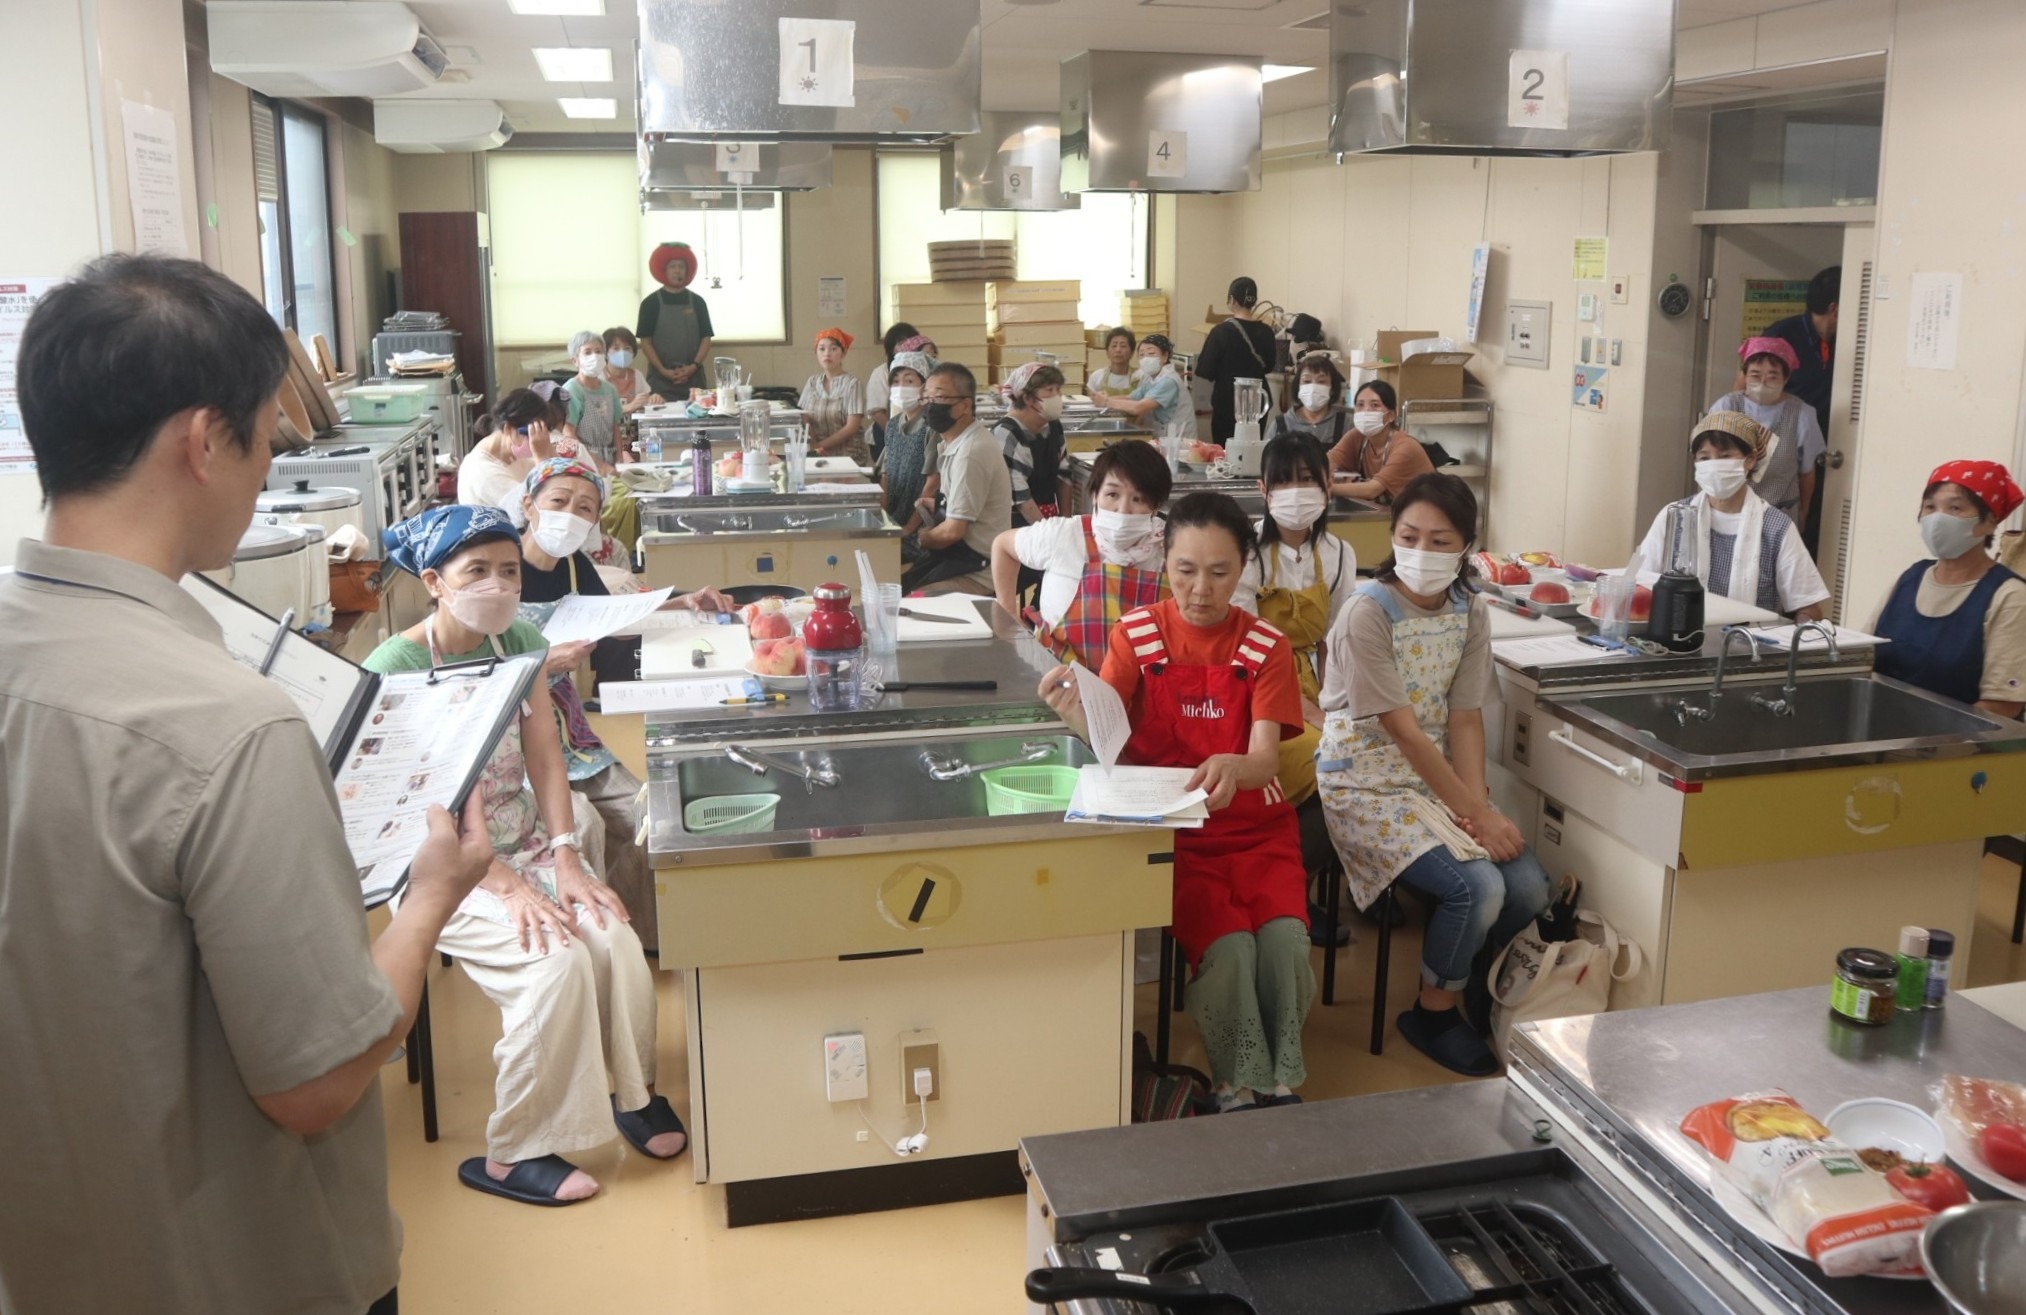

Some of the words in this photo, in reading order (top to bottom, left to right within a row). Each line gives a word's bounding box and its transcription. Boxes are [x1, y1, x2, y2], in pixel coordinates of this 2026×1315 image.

[798, 37, 817, 73] 1
[1521, 68, 1545, 101] 2
[1156, 141, 1171, 161] 4
[1009, 172, 1021, 188] 6
